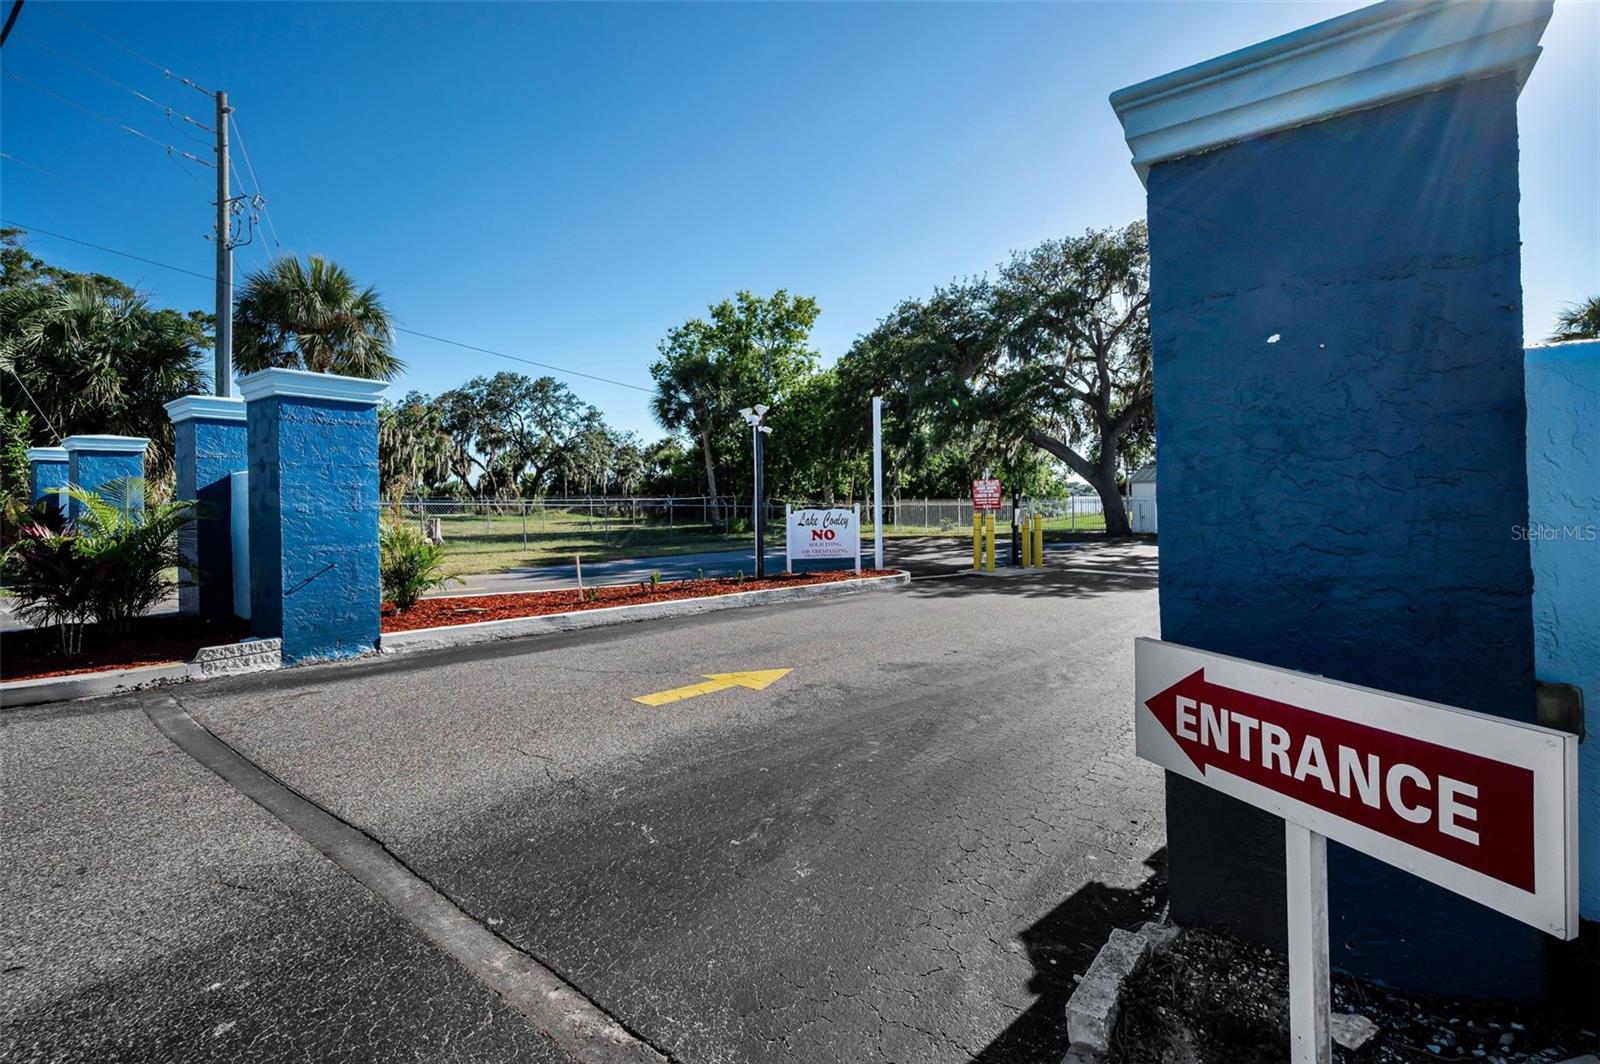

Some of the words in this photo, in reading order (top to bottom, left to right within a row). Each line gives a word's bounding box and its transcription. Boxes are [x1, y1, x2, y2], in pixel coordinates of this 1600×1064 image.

[797, 512, 818, 527] Lake
[811, 529, 836, 541] NO
[1175, 695, 1480, 846] ENTRANCE
